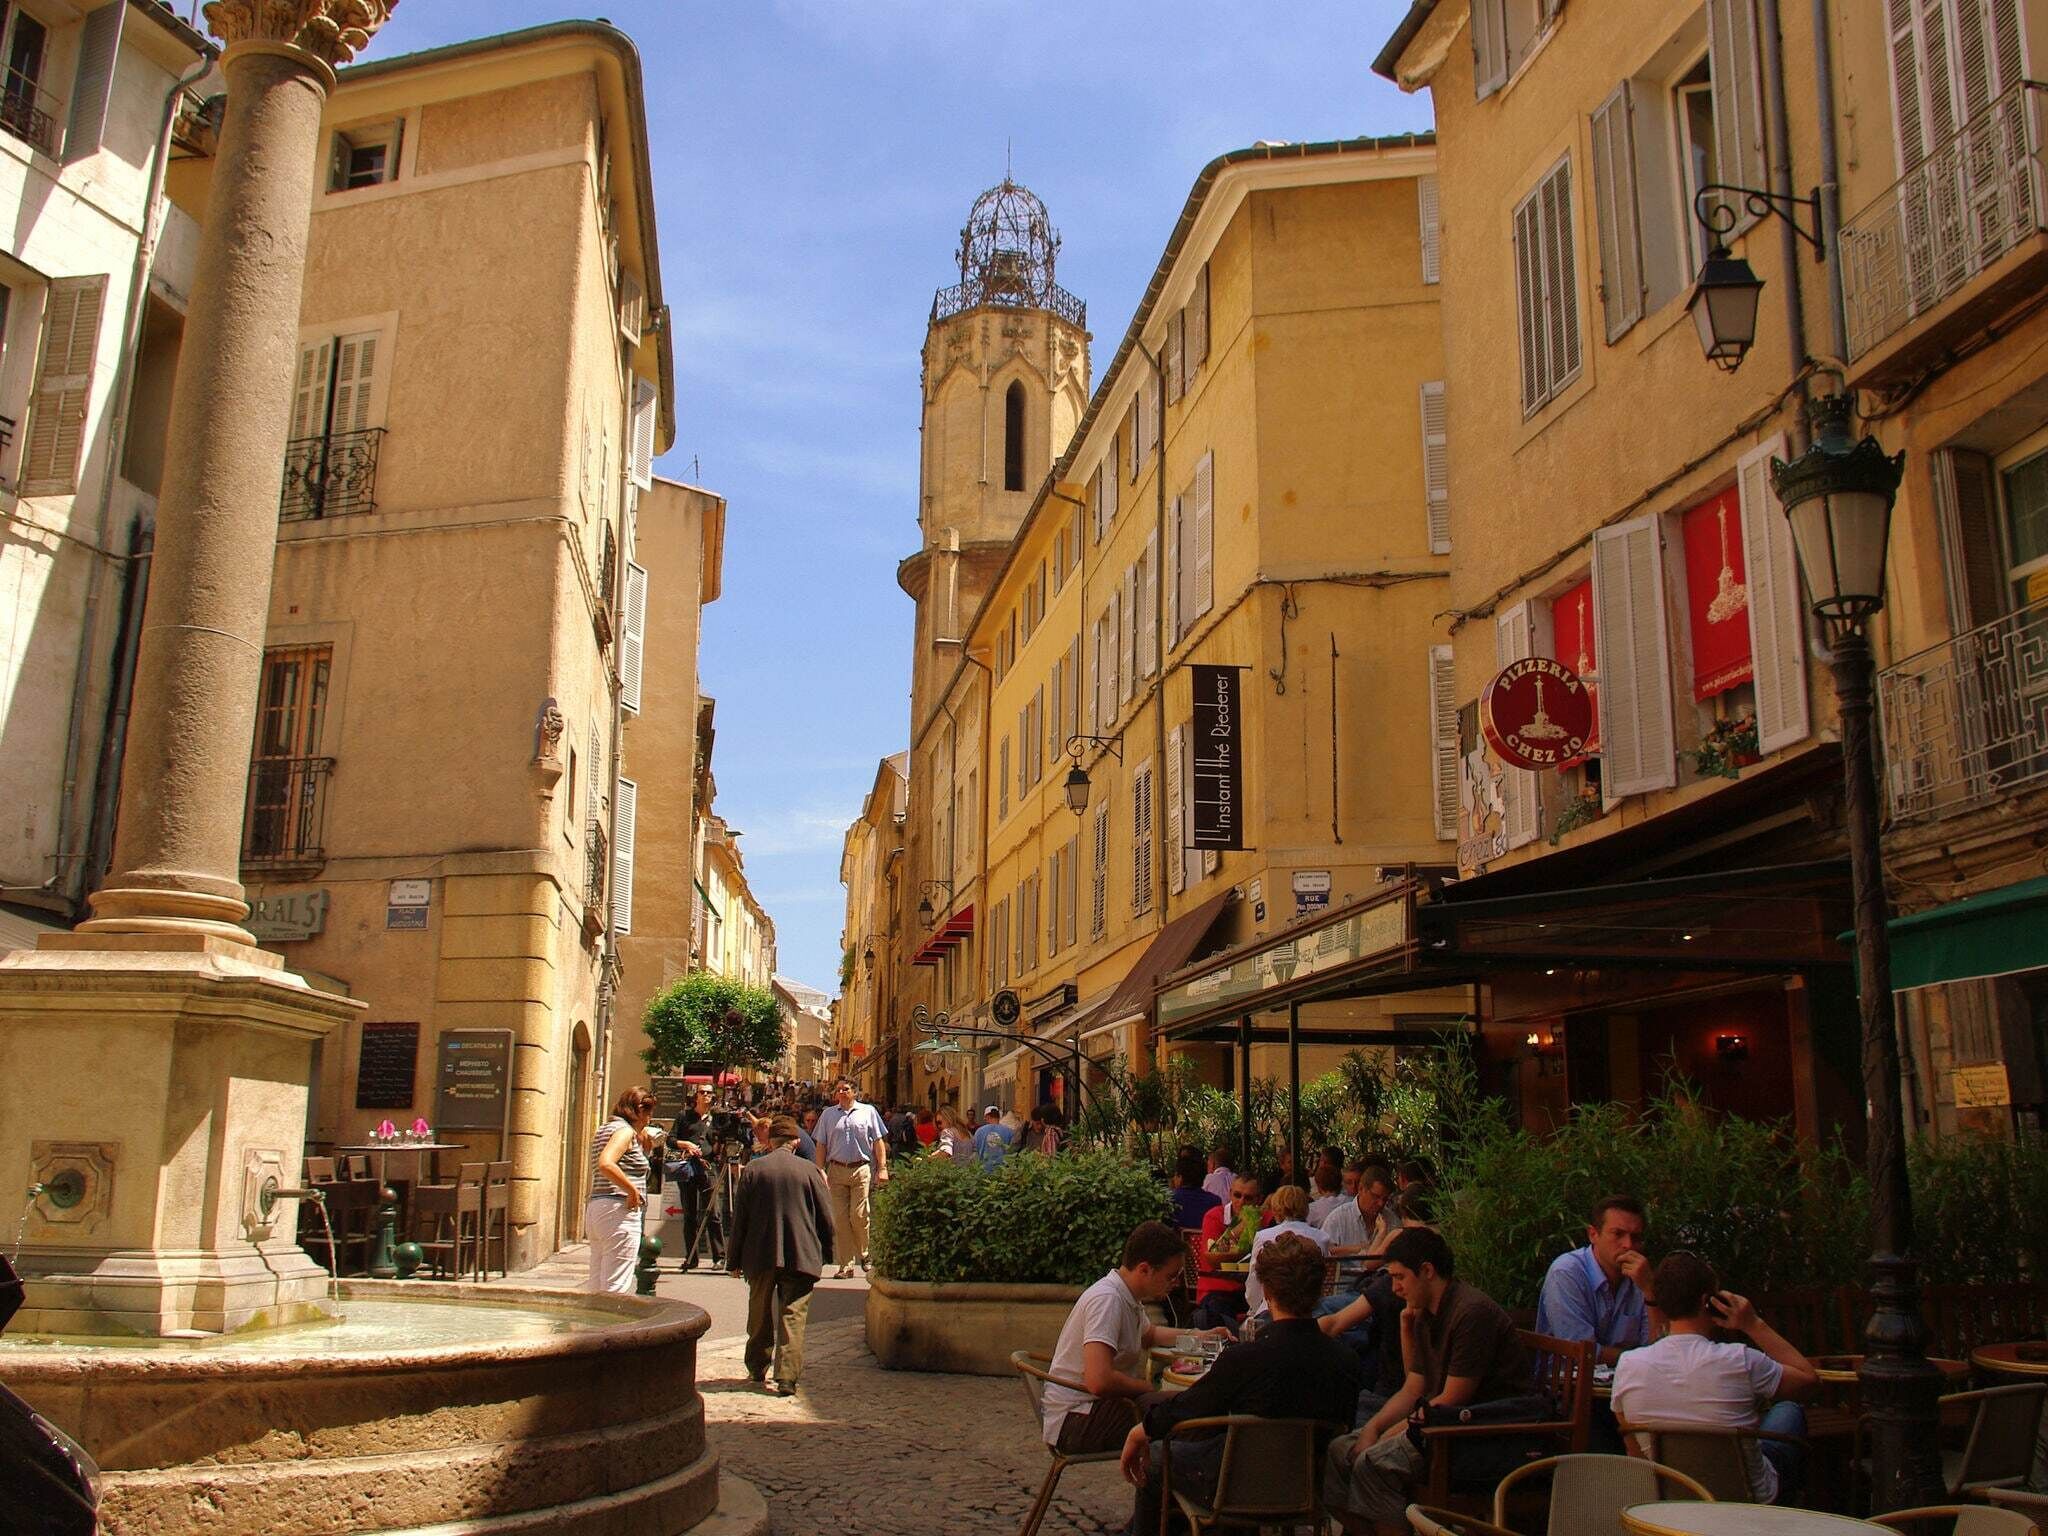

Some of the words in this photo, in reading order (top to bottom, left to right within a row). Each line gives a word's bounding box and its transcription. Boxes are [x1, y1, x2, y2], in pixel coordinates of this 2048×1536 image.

[1500, 659, 1579, 695] PIZZERIA
[1195, 674, 1230, 737] Riederer
[1506, 734, 1556, 762] CHEZ
[1563, 736, 1584, 758] JO
